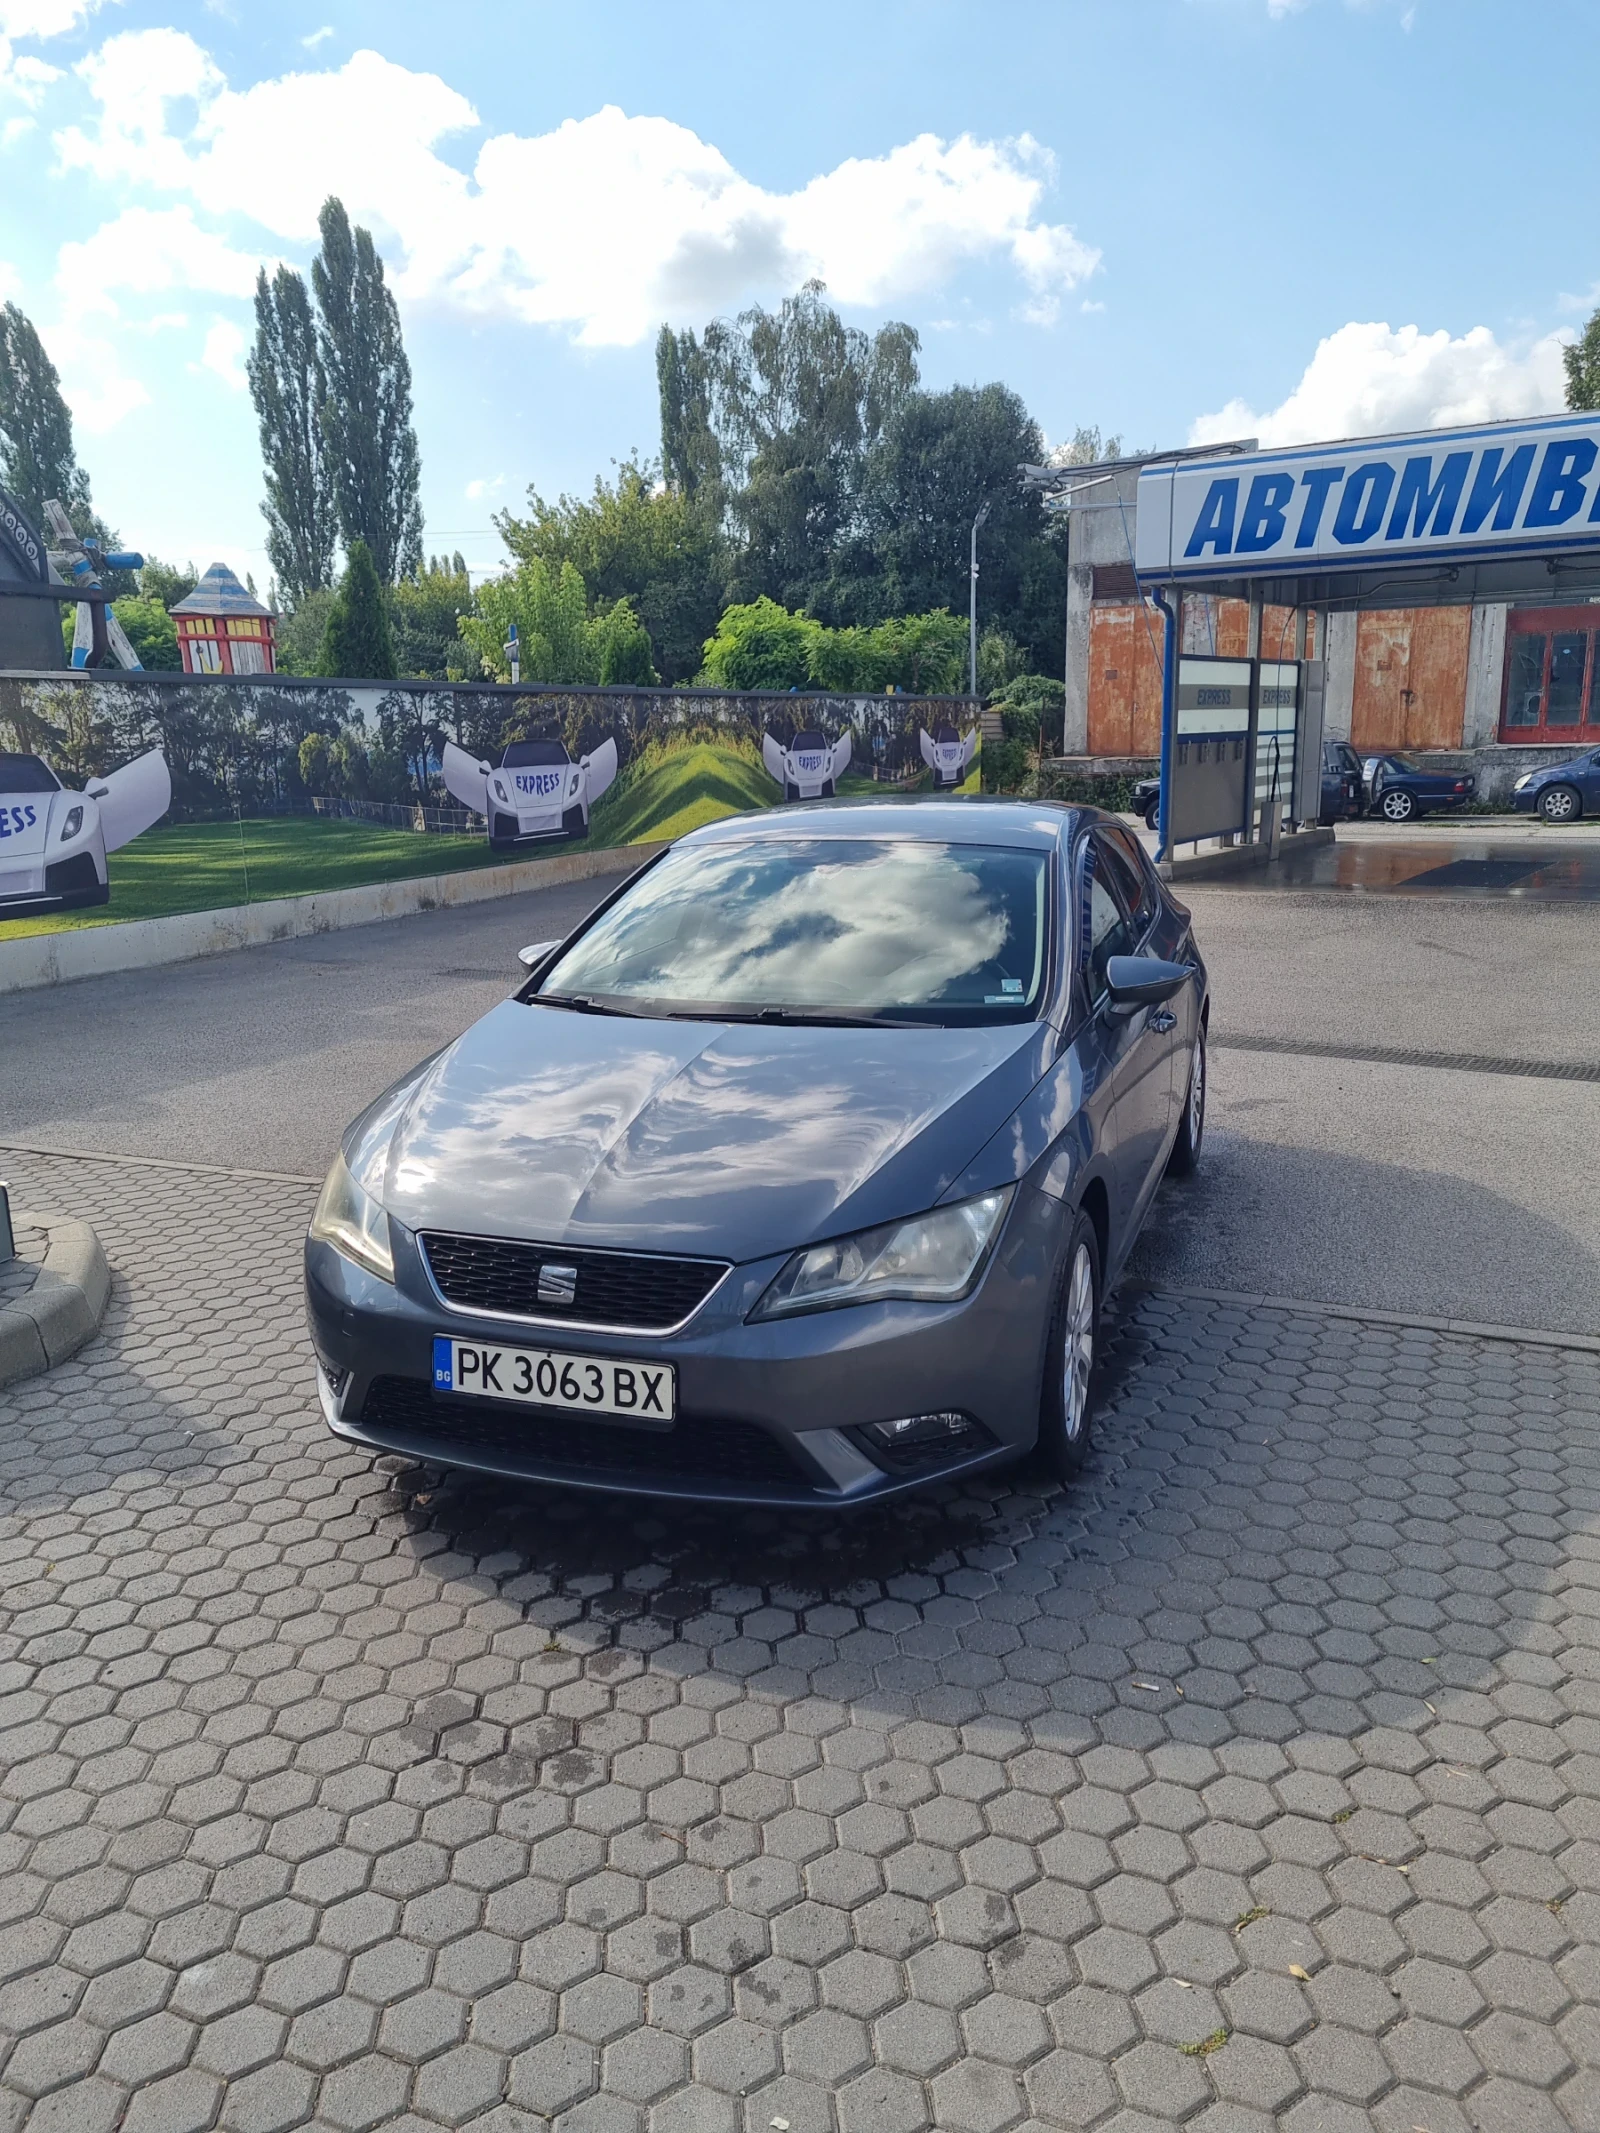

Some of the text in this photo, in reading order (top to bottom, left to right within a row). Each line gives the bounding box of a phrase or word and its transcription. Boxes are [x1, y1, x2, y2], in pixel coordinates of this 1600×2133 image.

[1183, 438, 1600, 557] АВТОМИВ
[1197, 689, 1231, 705] EXPRESS
[1263, 689, 1291, 704] EXPRESS
[799, 756, 821, 771] EXPRESS
[516, 773, 559, 797] EXPRESS
[436, 1369, 451, 1382] BG
[458, 1347, 664, 1412] PK 3063 BX
